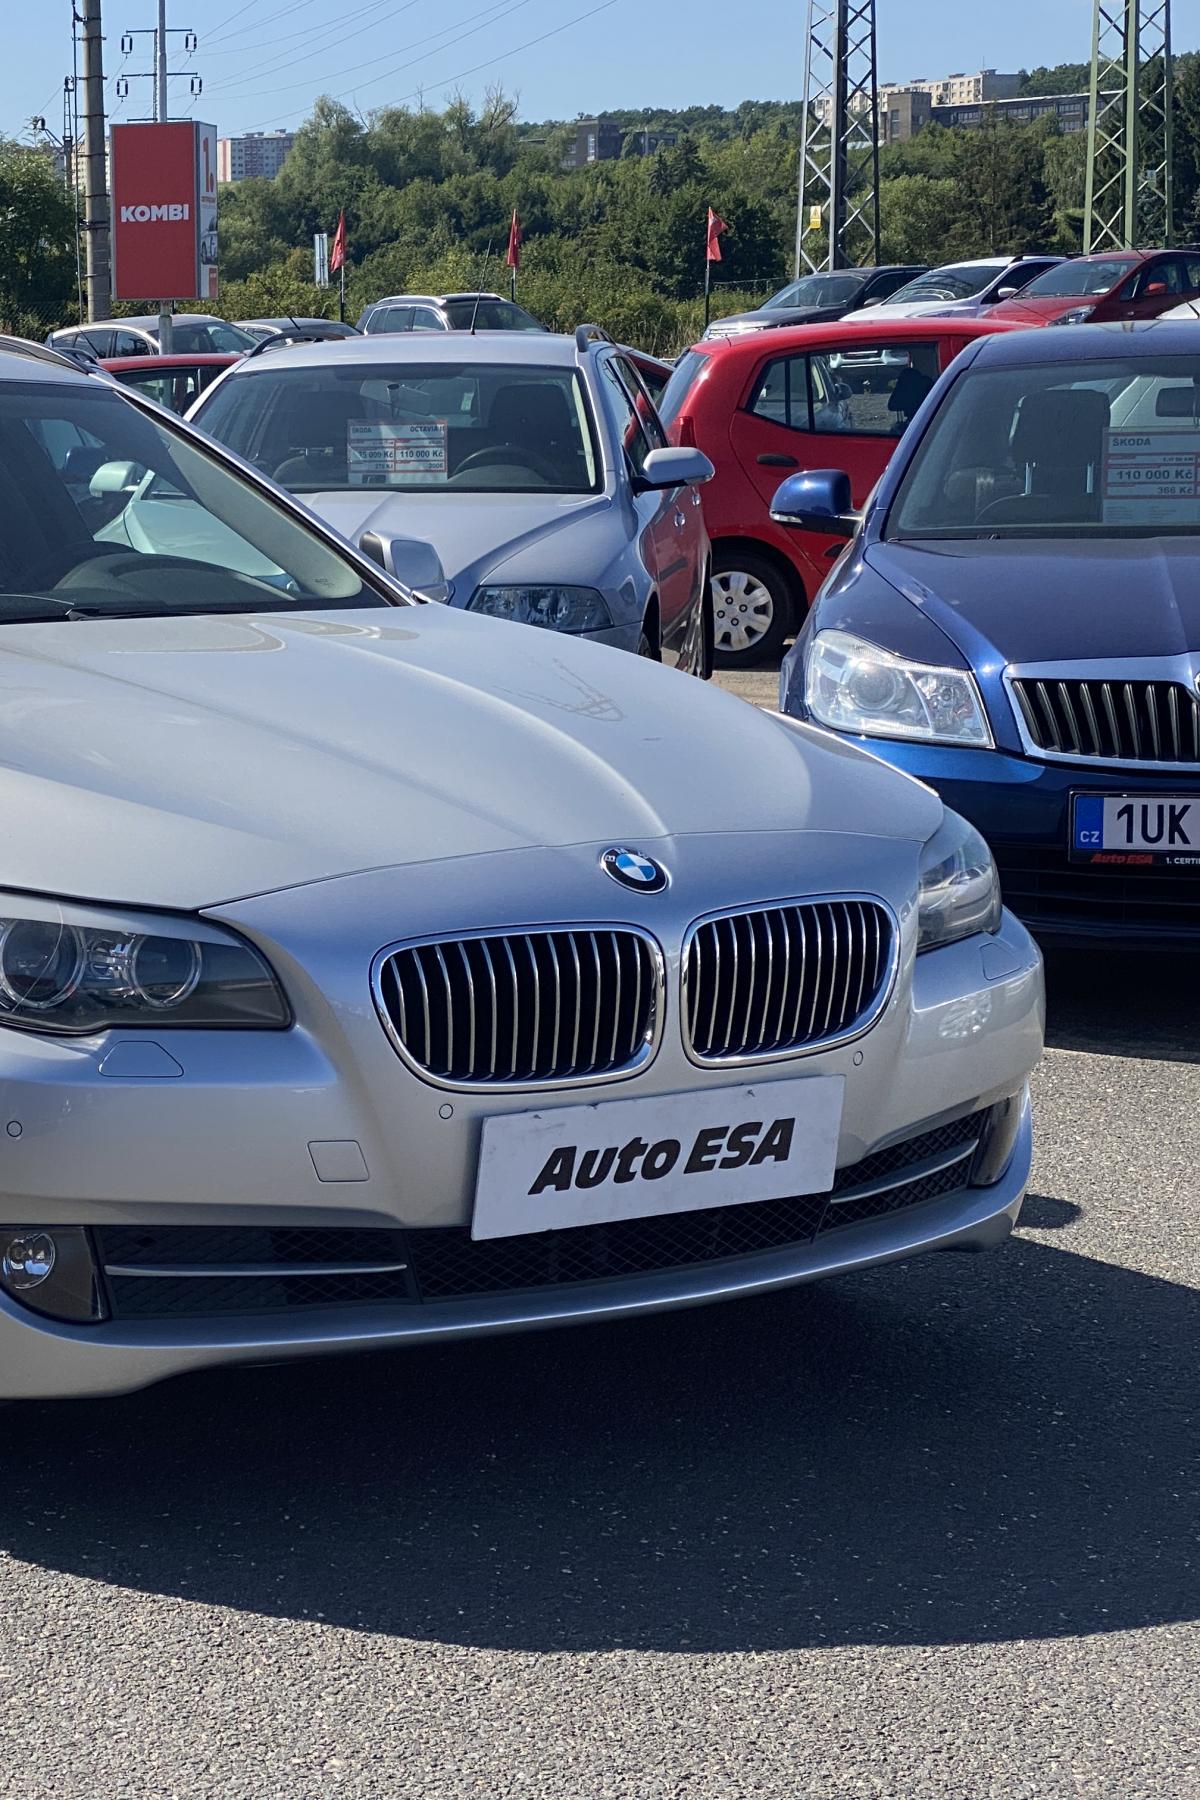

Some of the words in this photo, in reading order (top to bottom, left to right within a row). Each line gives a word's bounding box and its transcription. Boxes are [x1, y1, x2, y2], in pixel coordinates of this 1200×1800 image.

[121, 204, 189, 222] KOMBI
[1117, 470, 1141, 480] 110
[1145, 470, 1170, 480] 000
[1175, 469, 1192, 479] Kč
[1116, 803, 1192, 845] 1UK
[1080, 830, 1100, 843] CZ
[527, 1137, 681, 1196] Auto
[683, 1117, 796, 1175] ESA
